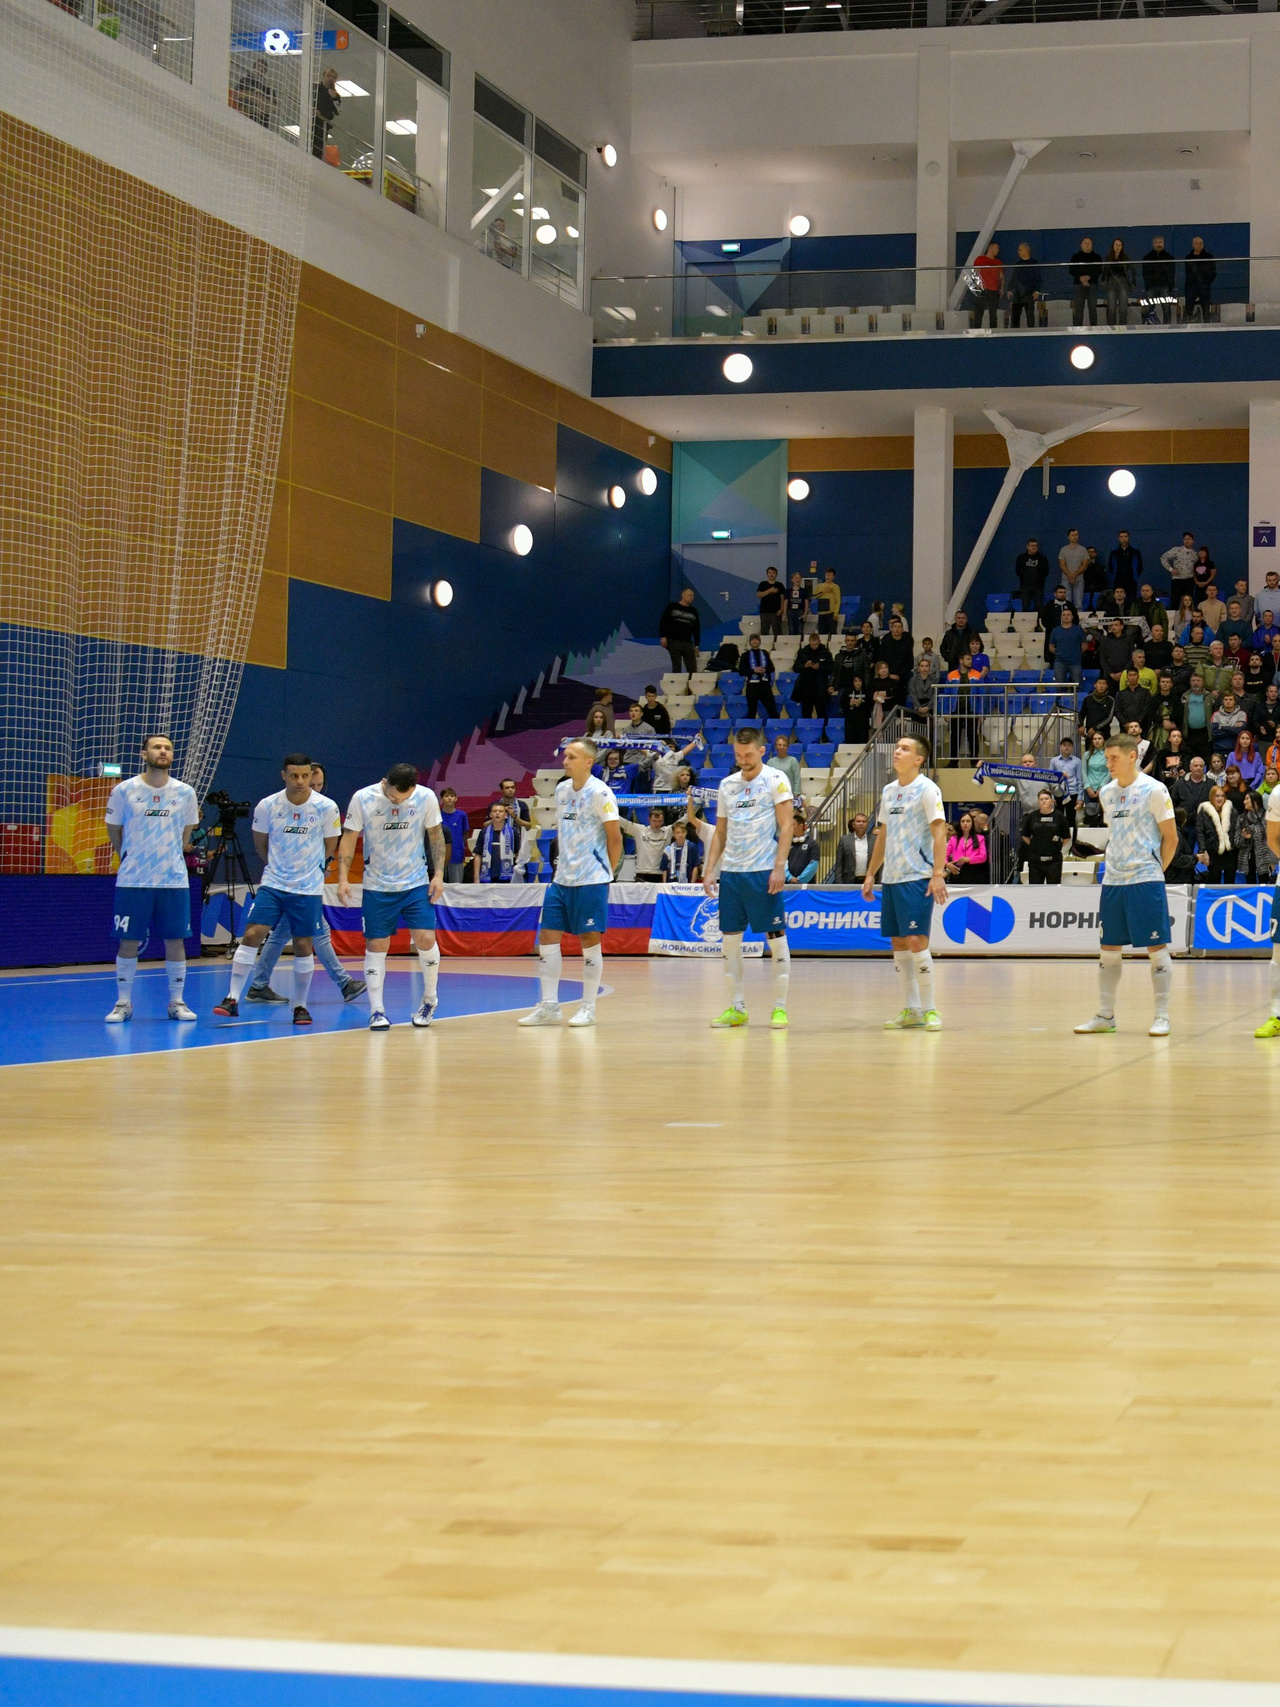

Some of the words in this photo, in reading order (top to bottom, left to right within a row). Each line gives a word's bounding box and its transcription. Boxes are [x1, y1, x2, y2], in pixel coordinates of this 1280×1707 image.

[736, 799, 756, 808] PARI
[283, 826, 308, 834] PARI
[383, 822, 409, 830] PARI
[114, 914, 130, 933] 94
[785, 911, 881, 929] ОРНИКЕ
